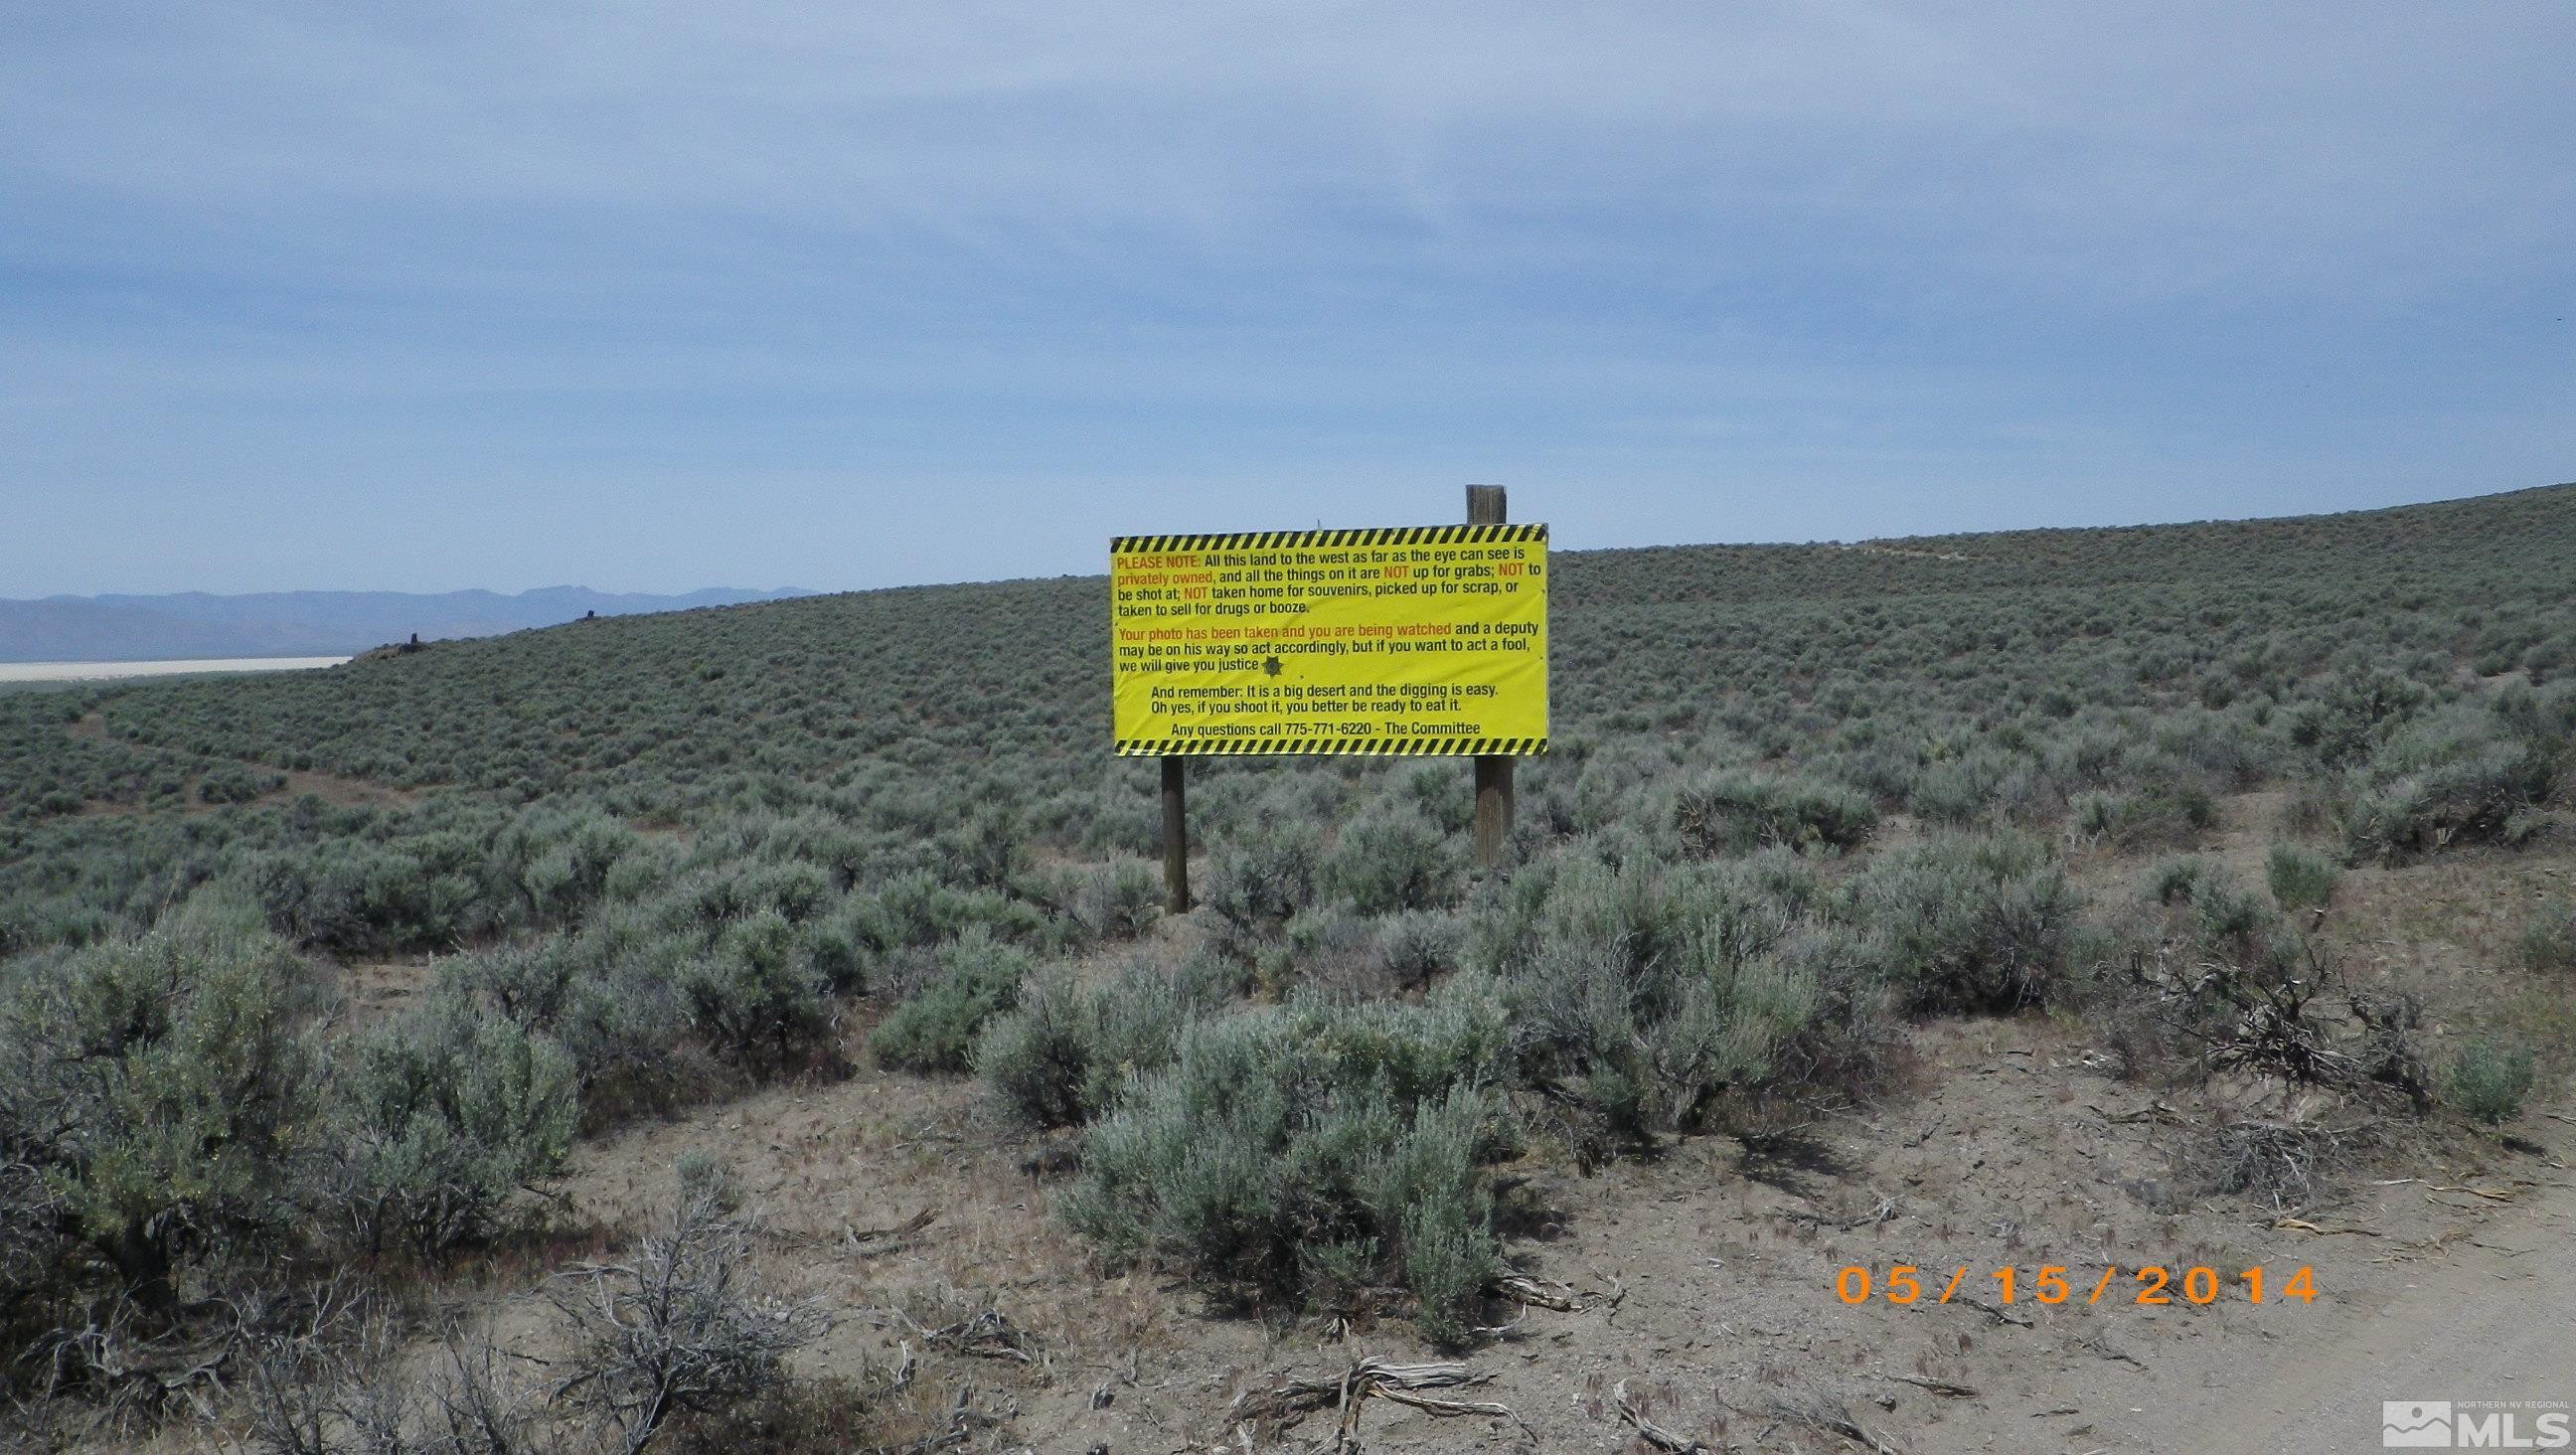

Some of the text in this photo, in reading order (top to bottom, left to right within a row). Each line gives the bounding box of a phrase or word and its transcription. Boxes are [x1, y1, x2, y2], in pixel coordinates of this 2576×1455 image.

[1117, 547, 1524, 569] PLEASE NOTE: All this land to the west as far as the eye can see is
[1118, 563, 1540, 587] privately owned, and all the things on it are NOT up for grabs; NOT to
[1119, 581, 1518, 601] be shot at; NOT taken home for souvenirs, picked up for scrap, or
[1119, 602, 1310, 617] taken to sell for drugs or booze.
[1119, 622, 1538, 642] Your photo has been taken and you are being watched and a deputy
[1119, 638, 1530, 658] may be on his way so act accordingly, but if you want to act a fool,
[1119, 658, 1258, 673] we will give you justice
[1152, 683, 1498, 699] And remember: It is a big desert and the digging is easy.
[1152, 698, 1461, 716] Oh yes, if you shoot it, you better be ready to eat it.
[1172, 723, 1193, 737] Any
[1198, 723, 1256, 736] questions
[1260, 723, 1281, 735] call
[1285, 722, 1371, 735] 775-771-6220
[1385, 722, 1408, 734] The
[1412, 722, 1480, 734] Committee
